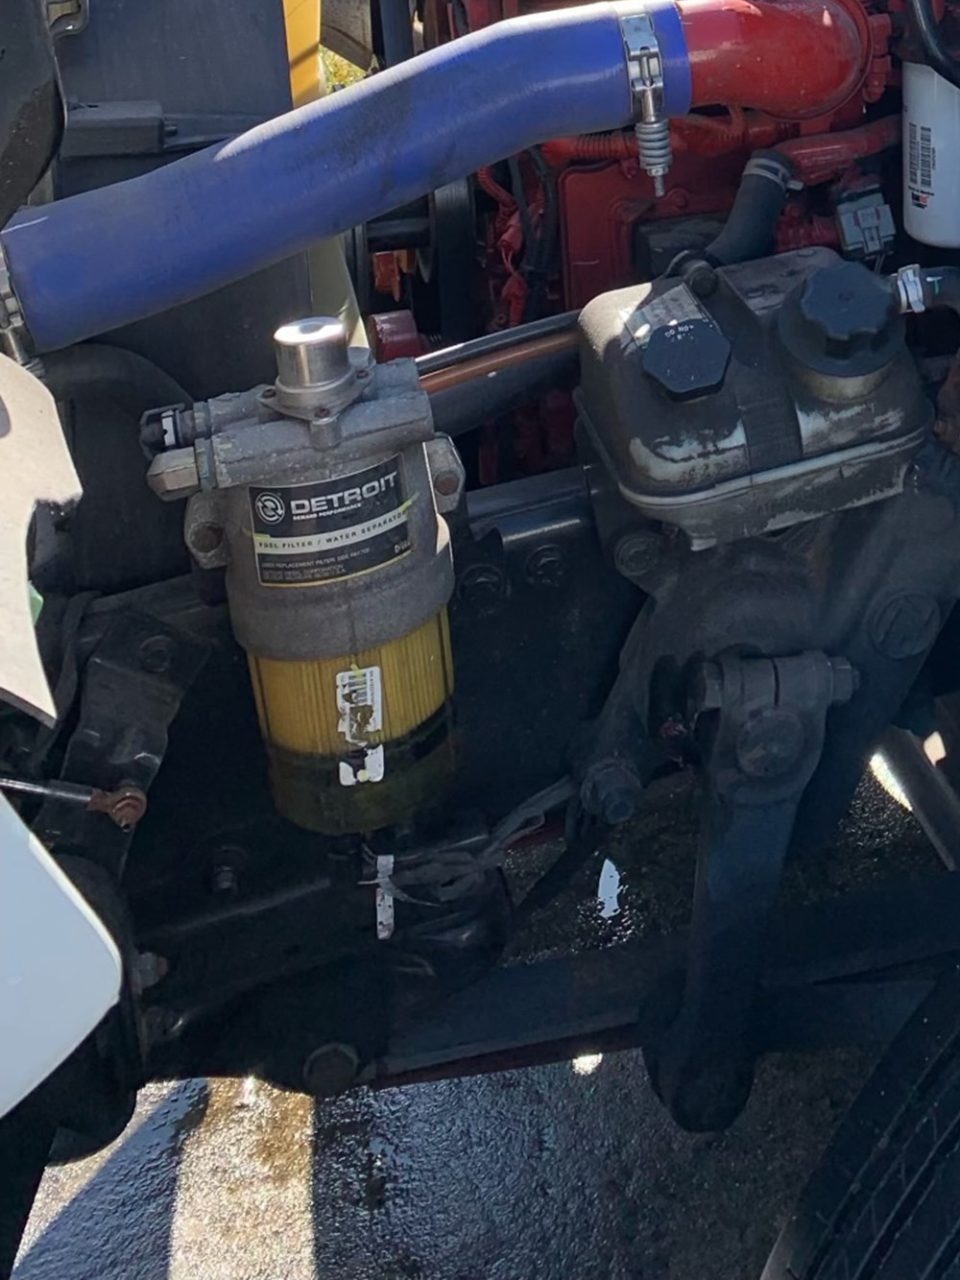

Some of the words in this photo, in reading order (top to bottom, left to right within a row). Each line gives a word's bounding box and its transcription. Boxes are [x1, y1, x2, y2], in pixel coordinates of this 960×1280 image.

[290, 471, 398, 515] DETROIT
[293, 513, 318, 521] DEMAND
[318, 503, 361, 517] PERFORMANCE
[258, 541, 279, 550] FUEL
[282, 540, 313, 549] FILTER
[325, 532, 357, 544] WATER
